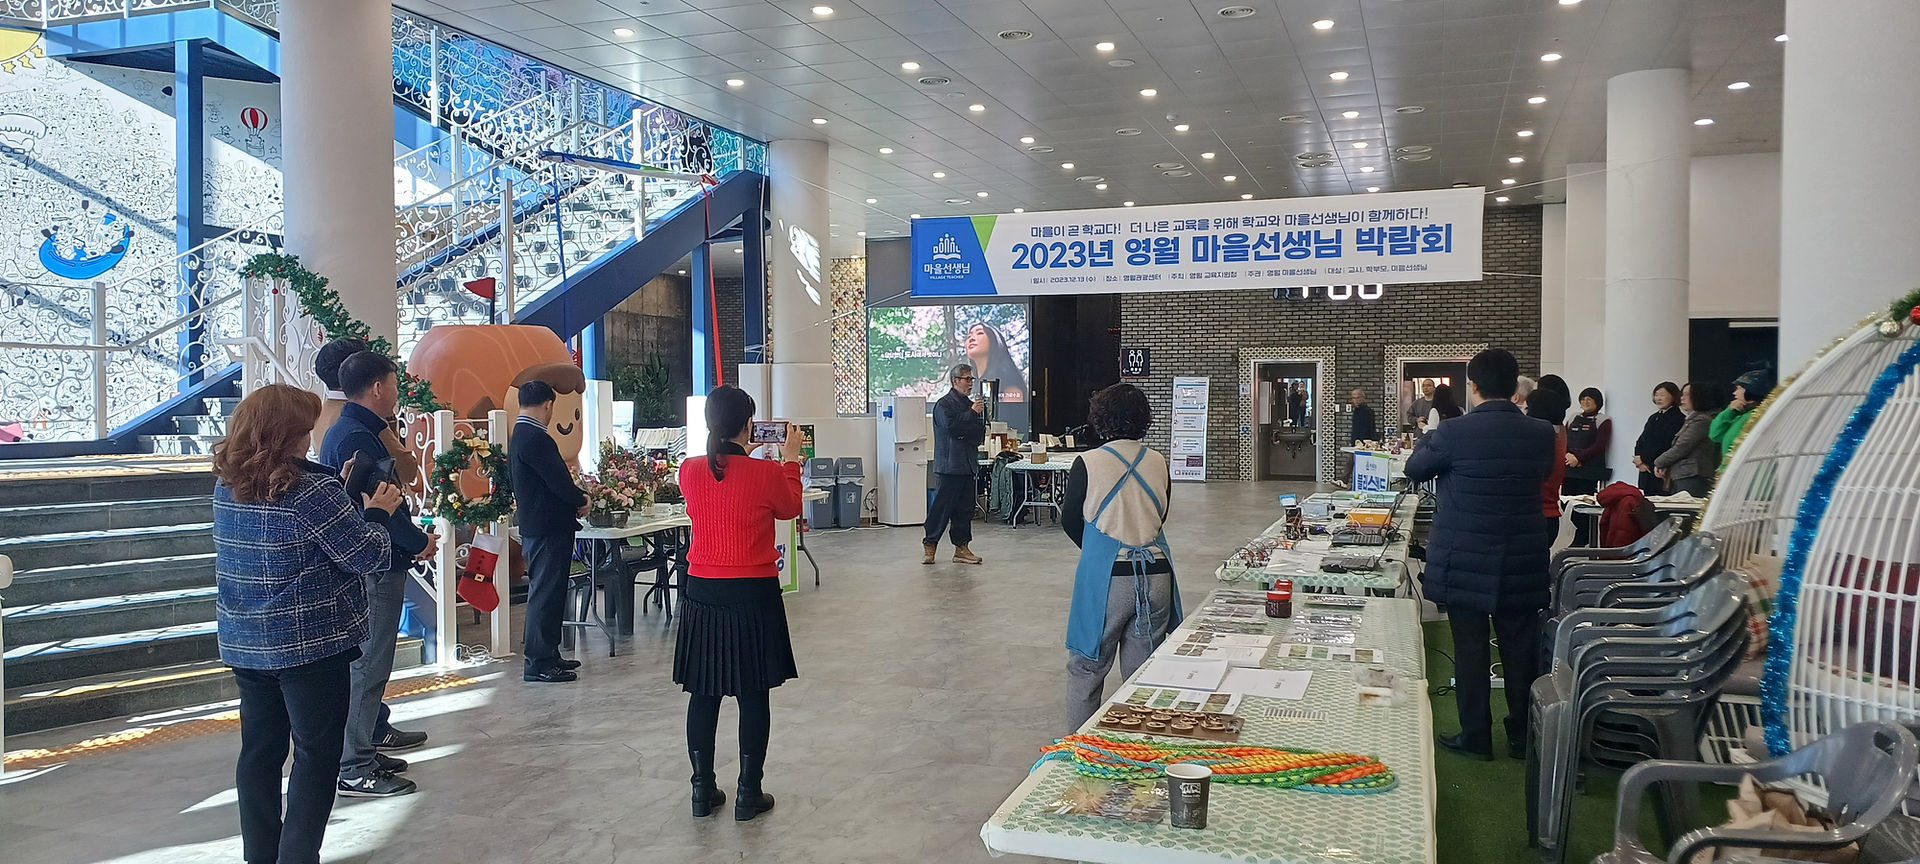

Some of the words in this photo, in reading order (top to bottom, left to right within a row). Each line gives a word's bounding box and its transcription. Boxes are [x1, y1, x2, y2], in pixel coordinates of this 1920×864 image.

[1031, 225, 1064, 237] 마을이
[1068, 224, 1079, 237] 곧
[1082, 223, 1121, 235] 학교다!
[1130, 222, 1142, 233] 더
[1145, 221, 1169, 233] 나은
[1173, 218, 1209, 232] 교육을
[1213, 217, 1239, 230] 위해
[1242, 215, 1280, 228] 학교와
[1284, 211, 1364, 226] 마을선생님이
[1368, 207, 1428, 222] 함께하다!
[1012, 239, 1114, 270] 2023년
[1125, 237, 1180, 266] 영월
[1192, 229, 1342, 263] 마을선생님
[1356, 223, 1452, 257] 박람회
[924, 262, 970, 274] 마을선생님
